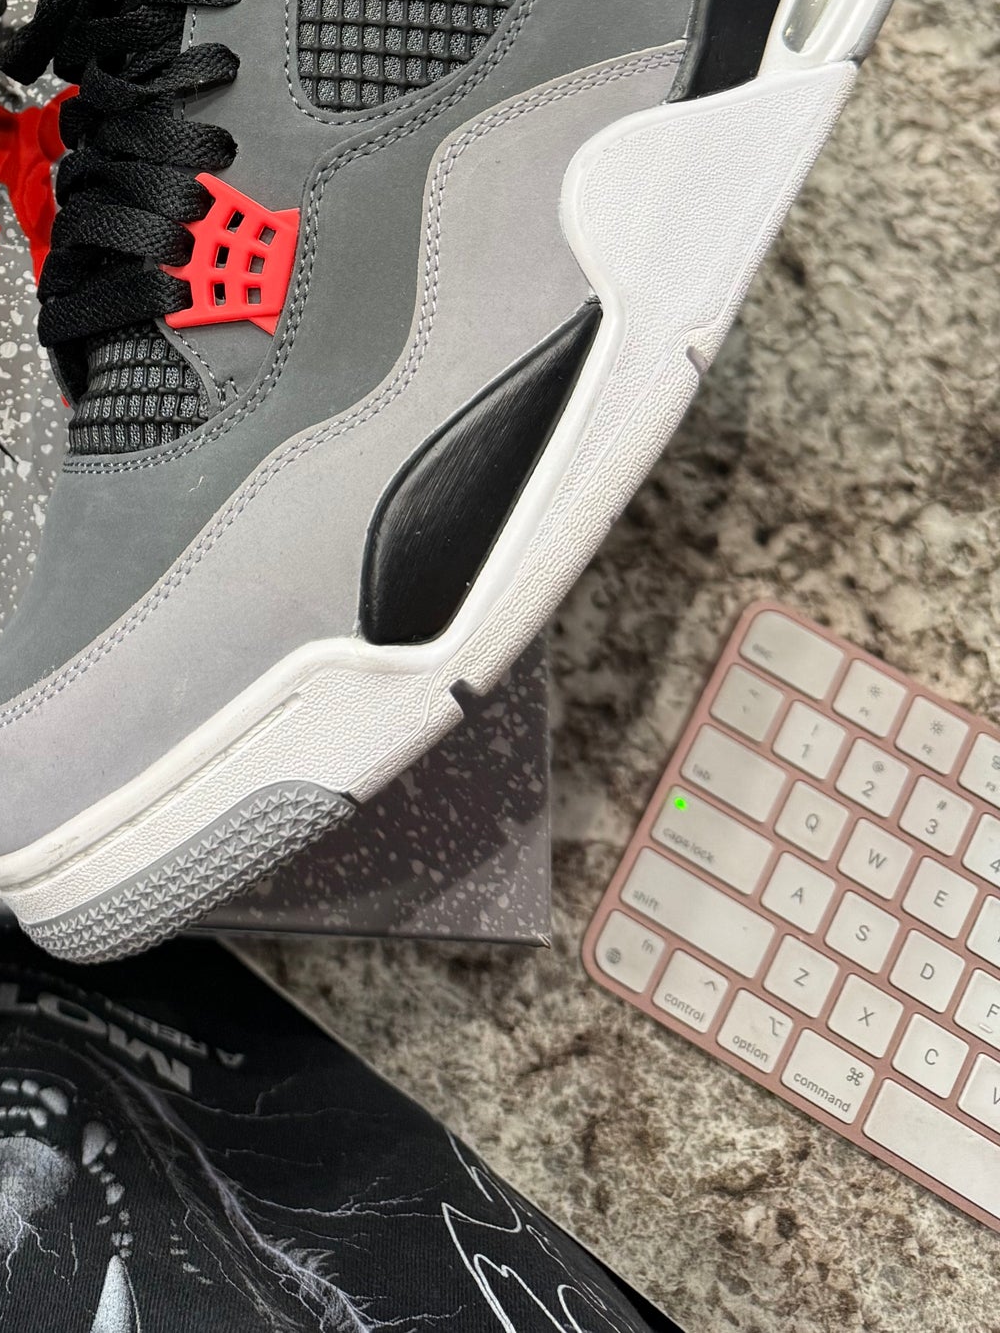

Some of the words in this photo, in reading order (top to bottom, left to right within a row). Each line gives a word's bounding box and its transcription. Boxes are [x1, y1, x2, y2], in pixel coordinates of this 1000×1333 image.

[861, 780, 876, 797] 2
[805, 813, 819, 834] Q
[924, 818, 939, 835] 3
[868, 848, 887, 869] W
[632, 889, 660, 913] shift
[790, 886, 804, 904] A
[933, 889, 949, 908] E
[855, 924, 870, 942] S
[641, 938, 655, 955] fn
[794, 967, 810, 987] Z
[920, 962, 935, 980] D
[663, 992, 705, 1023] control
[858, 1007, 875, 1027] X
[986, 1003, 1000, 1018] F
[732, 1035, 769, 1063] option
[924, 1048, 939, 1066] C
[793, 1072, 851, 1113] command
